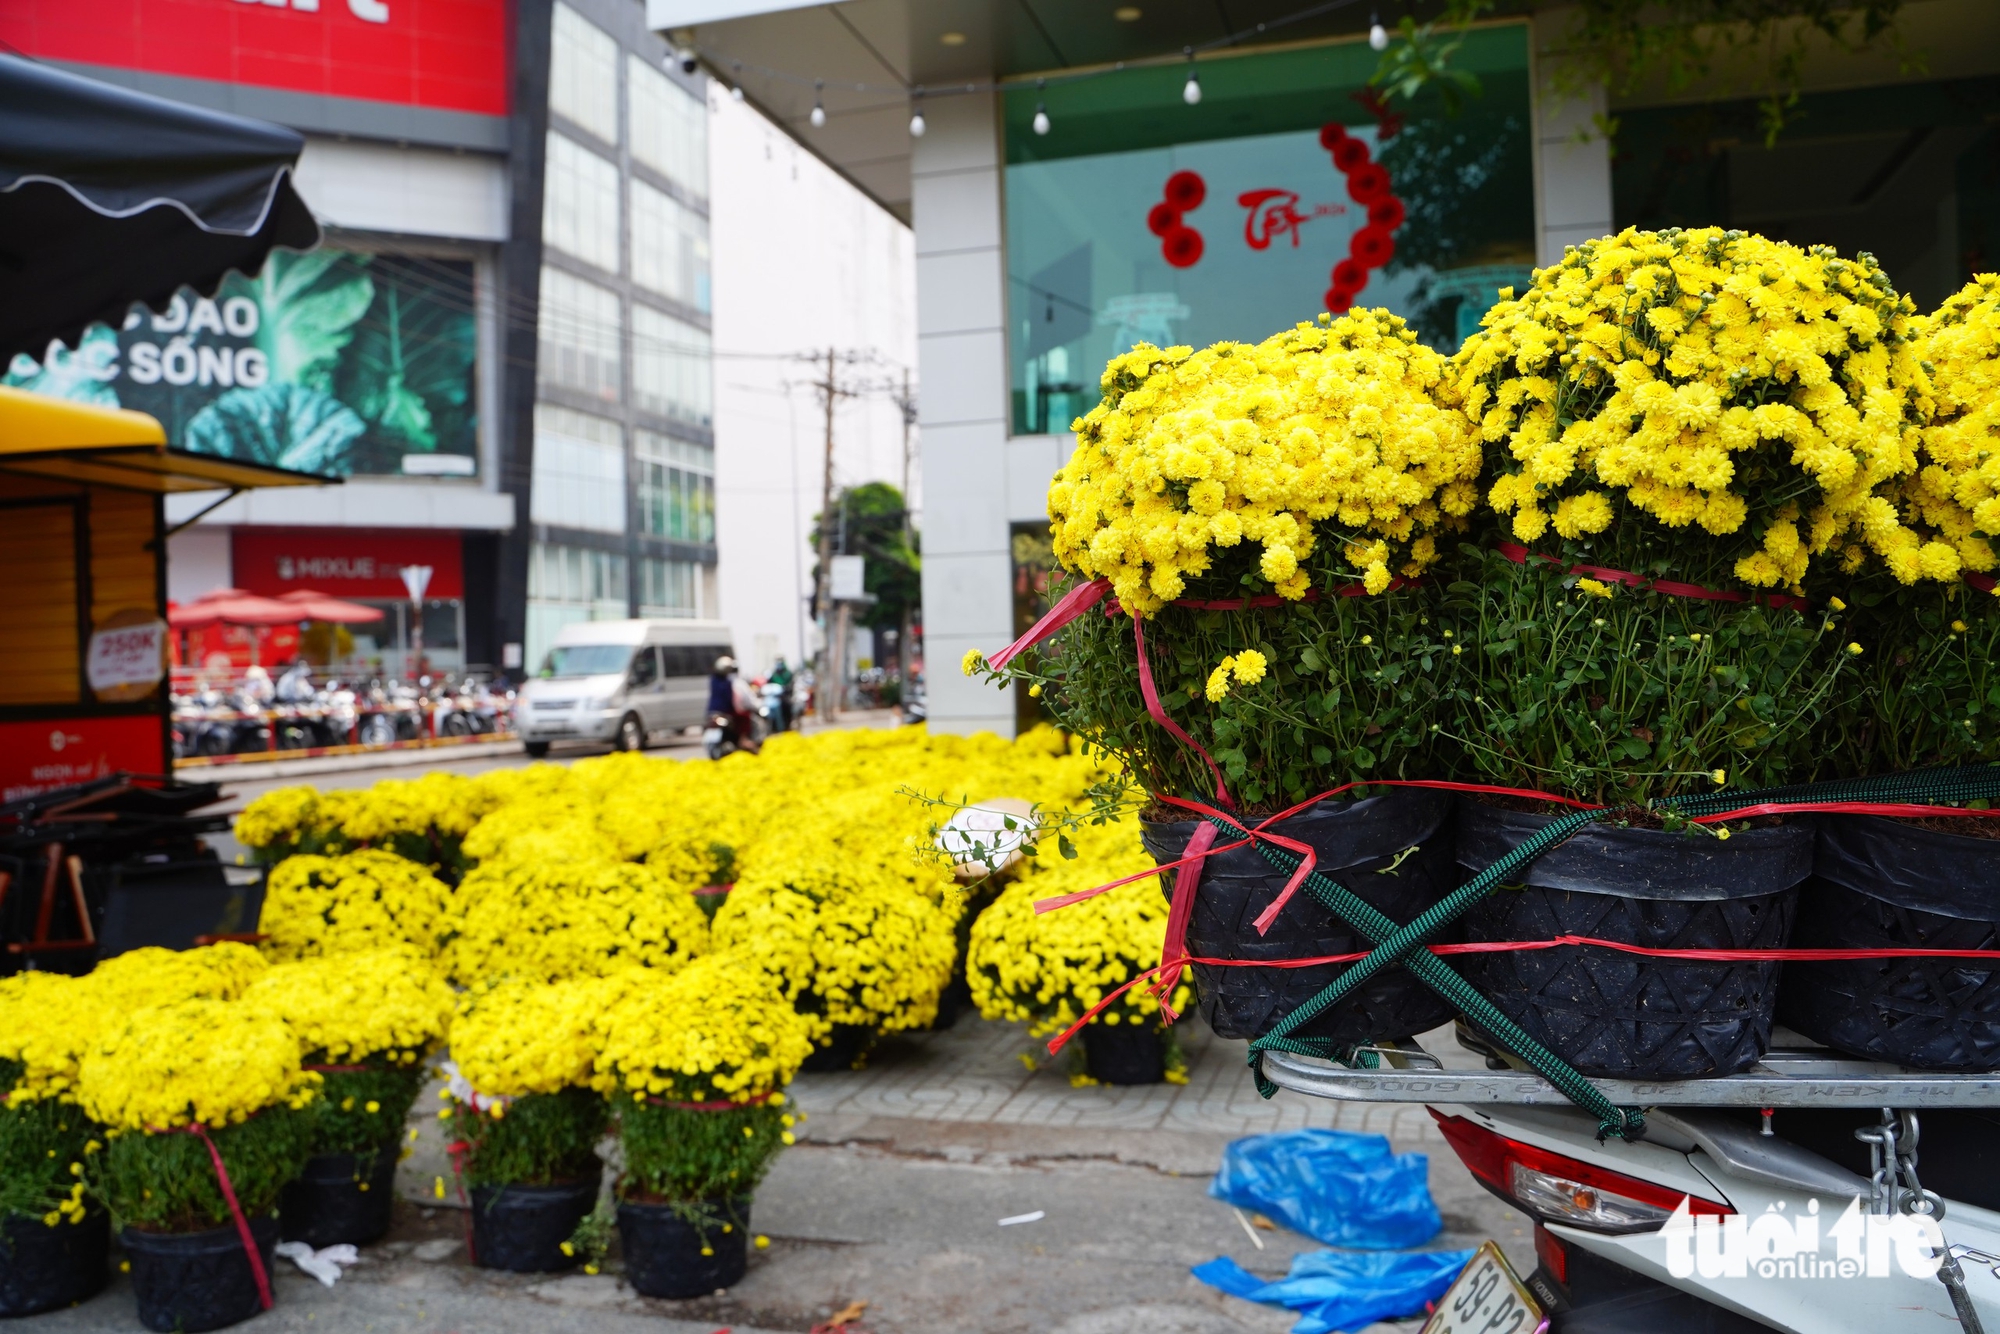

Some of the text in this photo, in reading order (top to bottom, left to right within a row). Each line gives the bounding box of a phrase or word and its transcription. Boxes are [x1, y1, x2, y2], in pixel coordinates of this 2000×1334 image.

[128, 335, 268, 388] SỐNG
[299, 556, 376, 579] MIXUE
[99, 630, 157, 657] 250K
[1530, 1276, 1558, 1309] HONDA
